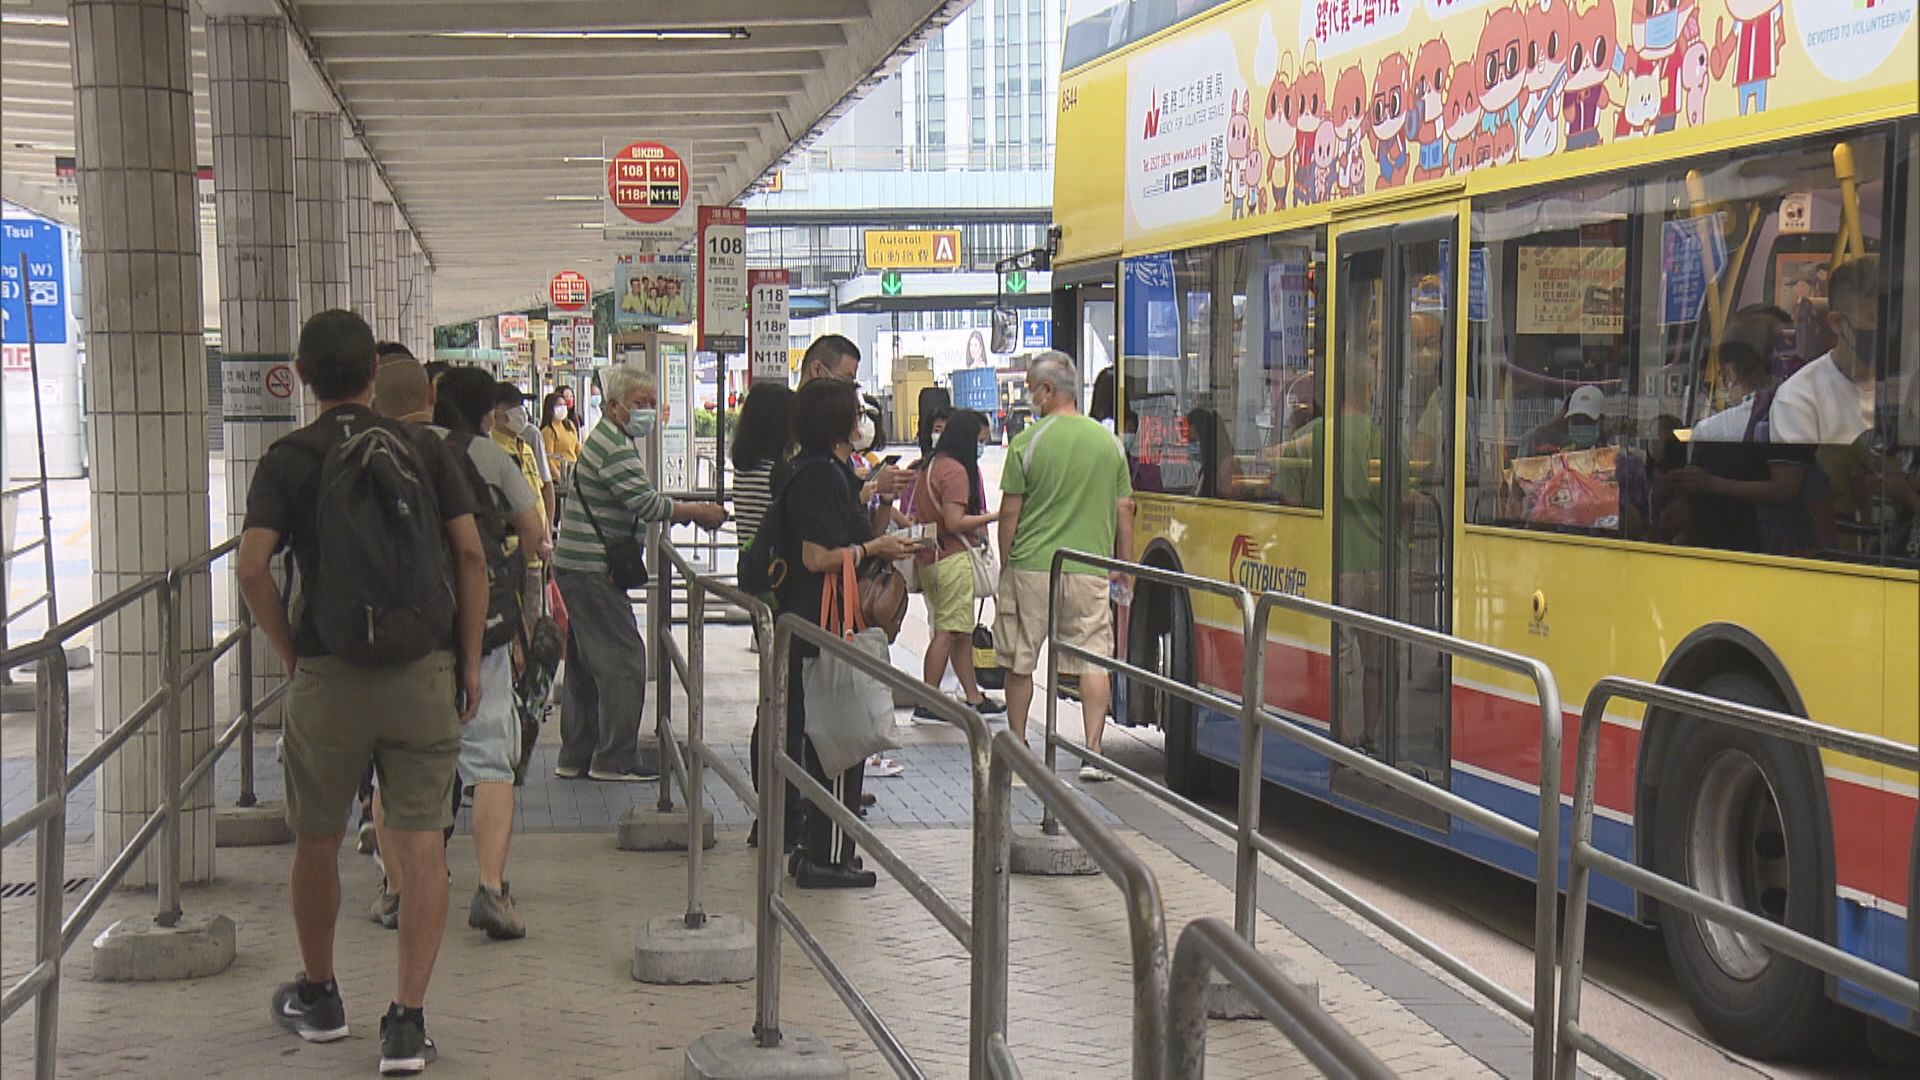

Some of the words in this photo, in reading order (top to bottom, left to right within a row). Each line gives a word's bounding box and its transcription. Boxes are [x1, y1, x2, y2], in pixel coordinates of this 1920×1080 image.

[1807, 26, 1840, 48] DEVOTED
[1841, 23, 1851, 39] TO
[1852, 8, 1911, 35] VOLUNTEERING
[622, 165, 643, 176] 108
[654, 165, 676, 178] 118
[620, 188, 647, 201] 118P
[651, 189, 679, 202] N118
[4, 224, 34, 238] Tsui
[708, 236, 743, 254] 108
[880, 235, 921, 244] Autotoll
[935, 236, 954, 261] A
[758, 288, 784, 302] 118
[754, 321, 786, 333] 118P
[754, 350, 787, 363] N118
[1239, 560, 1284, 592] CITYBUS
